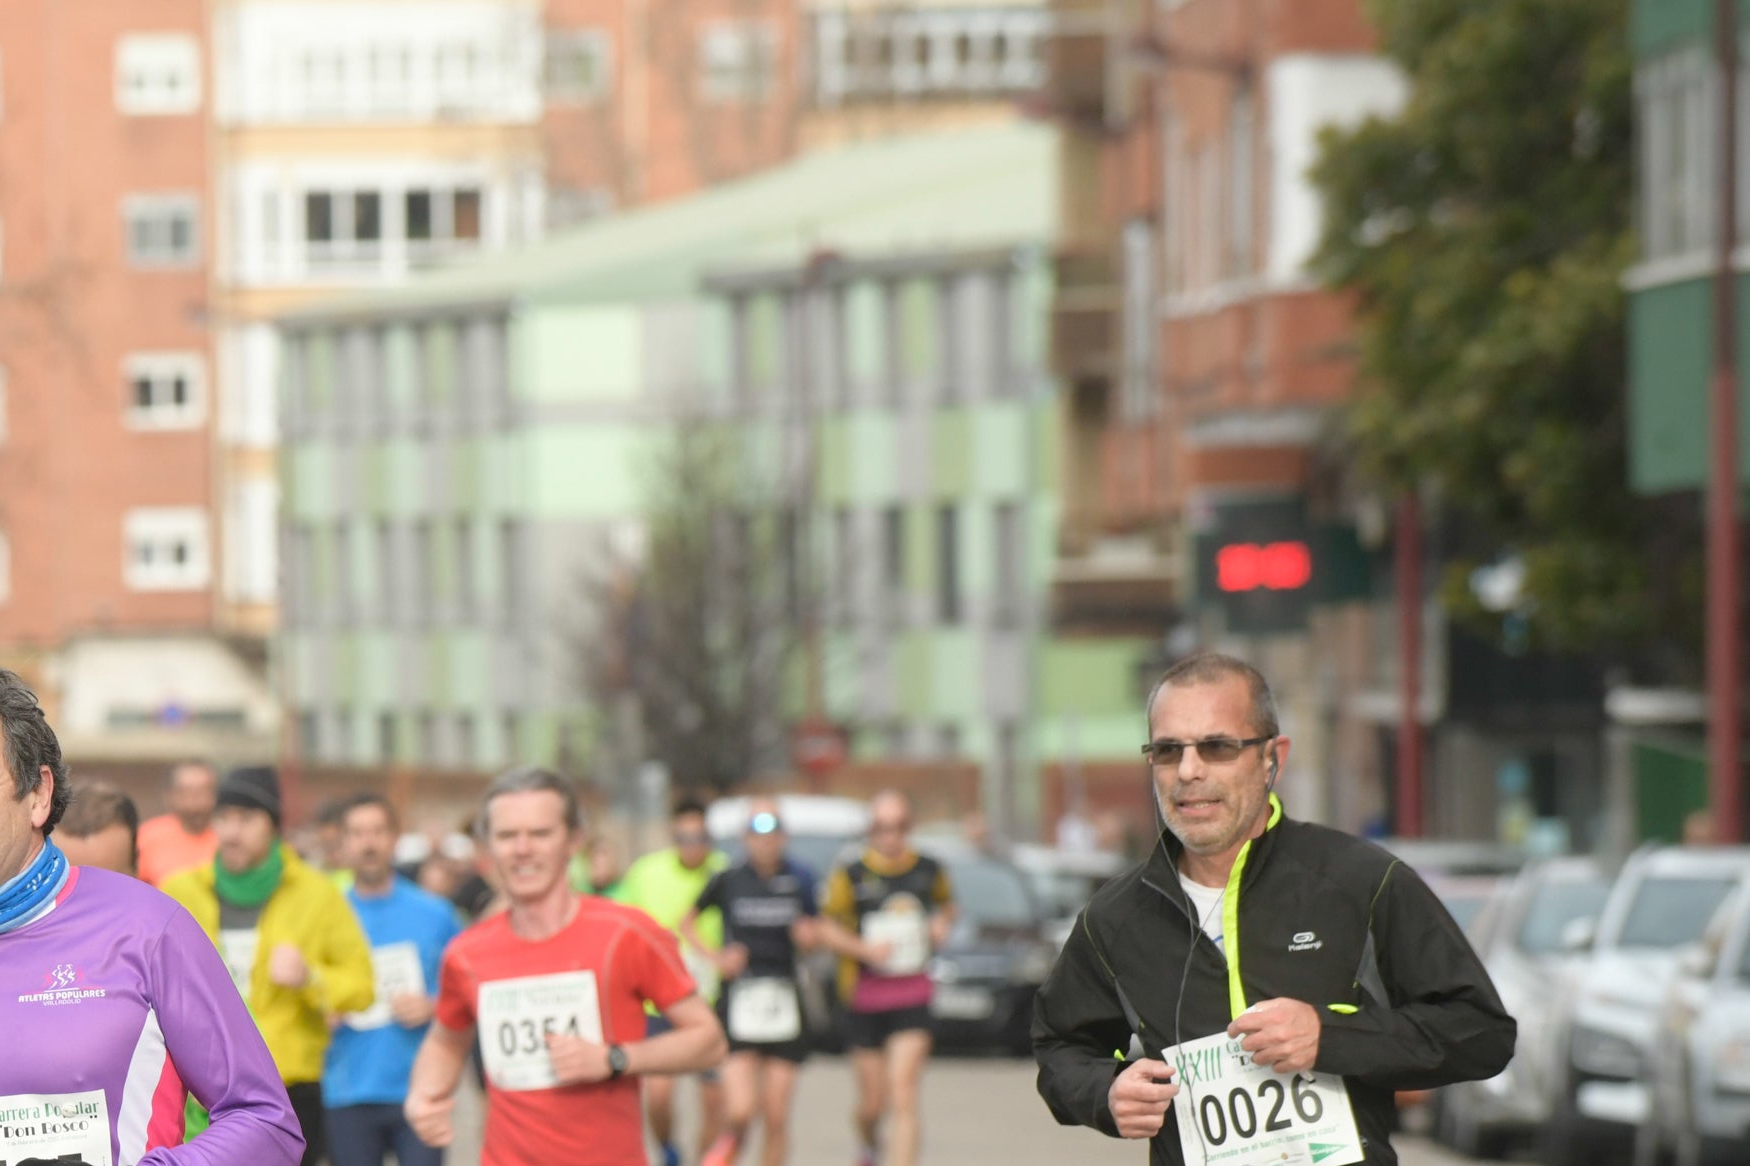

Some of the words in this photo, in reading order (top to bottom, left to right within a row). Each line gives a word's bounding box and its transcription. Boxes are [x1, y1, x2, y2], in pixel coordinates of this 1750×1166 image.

[18, 992, 54, 1003] ATLETAS
[55, 988, 105, 1000] POPULARES
[1176, 1046, 1222, 1088] XXIII
[1200, 1073, 1323, 1147] 0026
